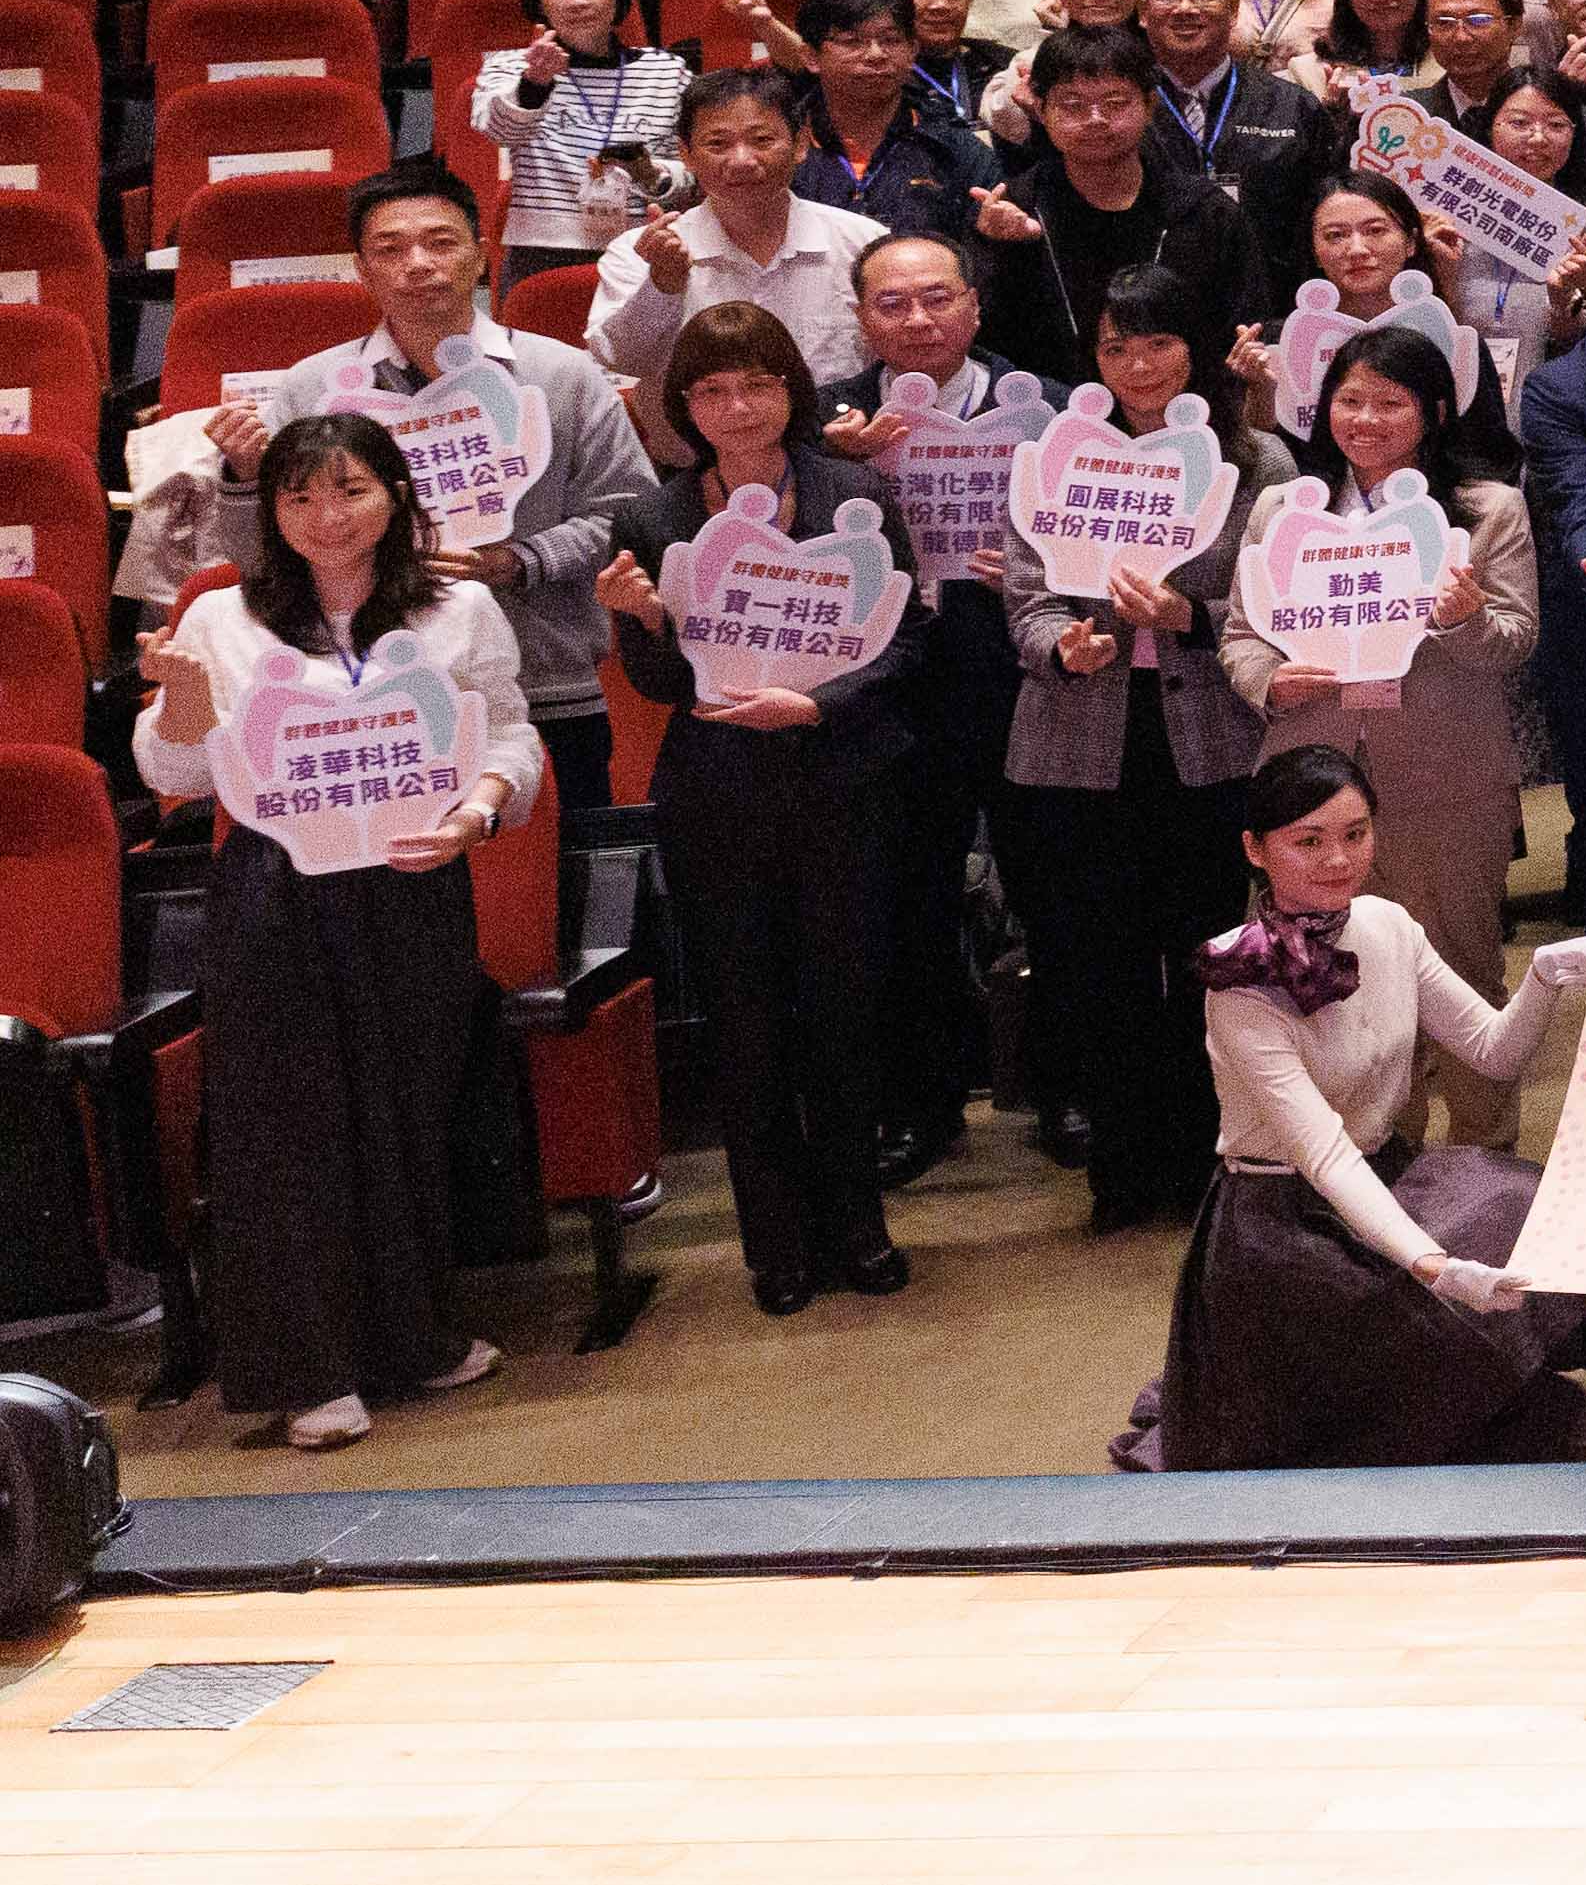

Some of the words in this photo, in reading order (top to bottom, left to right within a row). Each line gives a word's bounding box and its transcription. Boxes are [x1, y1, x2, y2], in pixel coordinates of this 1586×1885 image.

[1235, 124, 1296, 139] TAIPOWER
[1445, 162, 1558, 240] 群創光電股份
[1421, 179, 1555, 269] 有限公司南廠區
[1065, 484, 1174, 517] 圓展科技
[1031, 511, 1196, 548] 股份有限公司
[1327, 571, 1384, 598] 勤美
[722, 589, 843, 627] 寶一科技
[683, 616, 866, 661] 股份有限公司
[286, 740, 423, 781] 凌華科技
[256, 766, 460, 819] 股份有限公司
